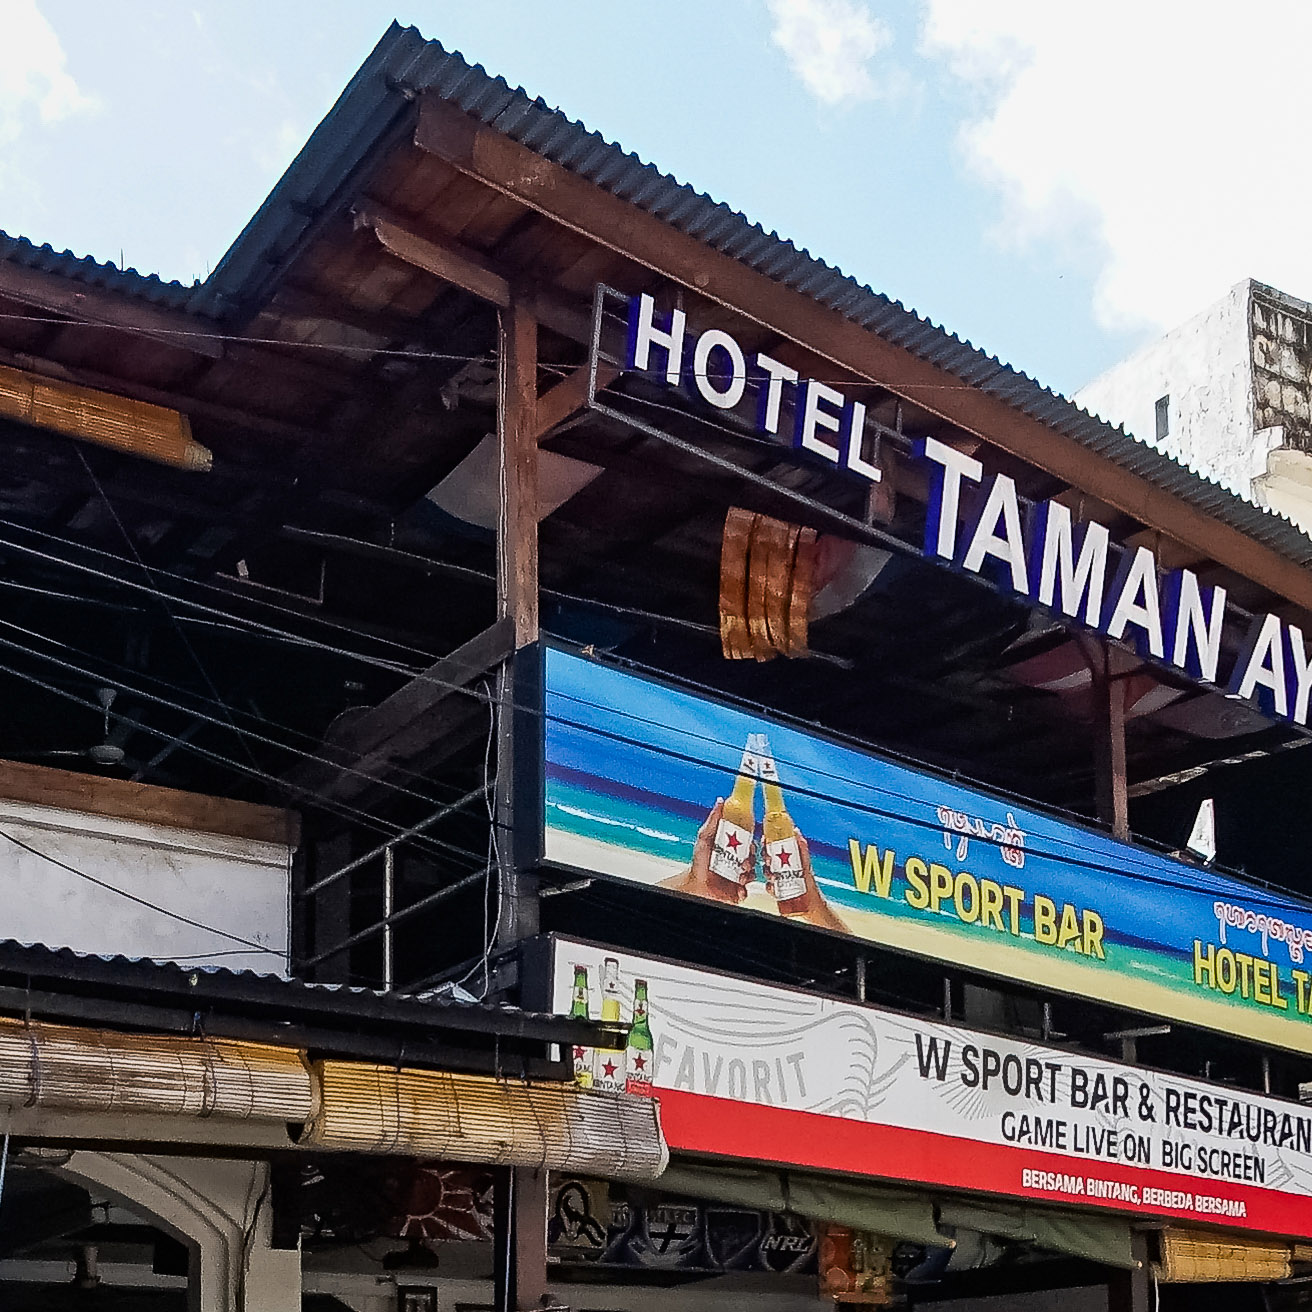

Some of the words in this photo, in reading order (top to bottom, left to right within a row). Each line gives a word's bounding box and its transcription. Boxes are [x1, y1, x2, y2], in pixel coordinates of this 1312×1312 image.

[632, 293, 882, 482] HOTEL
[924, 437, 1226, 682] TAMAN
[848, 839, 894, 899] W
[904, 857, 1026, 936] SPORT
[1034, 900, 1106, 960] BAR
[1193, 939, 1287, 1009] HOTEL
[656, 1032, 806, 1103] FAVORIT
[915, 1033, 952, 1080] W
[961, 1044, 1061, 1100] SPORT
[1070, 1068, 1130, 1115] BAR
[1138, 1081, 1157, 1122] &
[1001, 1111, 1067, 1151] GAME
[1073, 1122, 1118, 1160] LIVE
[1123, 1133, 1151, 1164] ON
[1161, 1137, 1192, 1171] BIG
[1197, 1145, 1266, 1183] SCREEN
[1022, 1168, 1086, 1196] BERSAMA
[1086, 1178, 1142, 1206] BINTANG,
[1142, 1186, 1194, 1211] BERBEDA
[1194, 1194, 1247, 1218] BERSAMA
[763, 1235, 813, 1252] NRL
